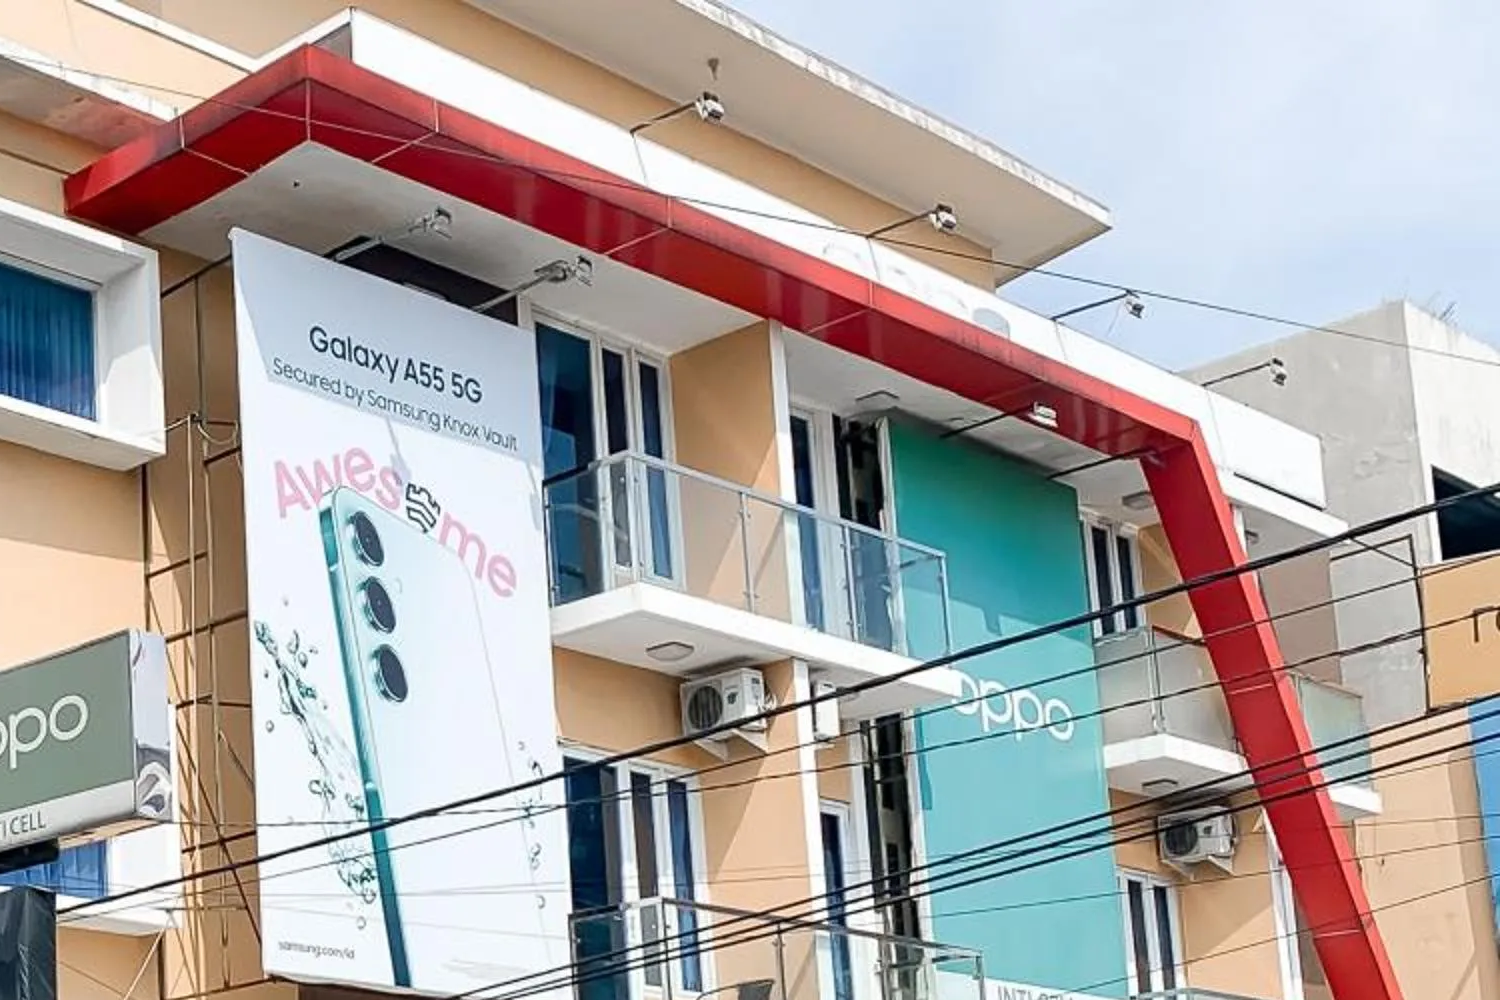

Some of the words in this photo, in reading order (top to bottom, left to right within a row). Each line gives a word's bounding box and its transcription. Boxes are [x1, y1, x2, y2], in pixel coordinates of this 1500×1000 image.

[309, 326, 398, 383] Galaxy
[404, 358, 445, 393] A55
[451, 374, 483, 403] 5G
[273, 358, 341, 395] Secured
[345, 383, 364, 406] by
[367, 390, 441, 433] Samsung
[443, 414, 480, 439] Knox
[482, 429, 518, 451] Vault
[954, 669, 1075, 741] oppo
[11, 811, 47, 836] CELL
